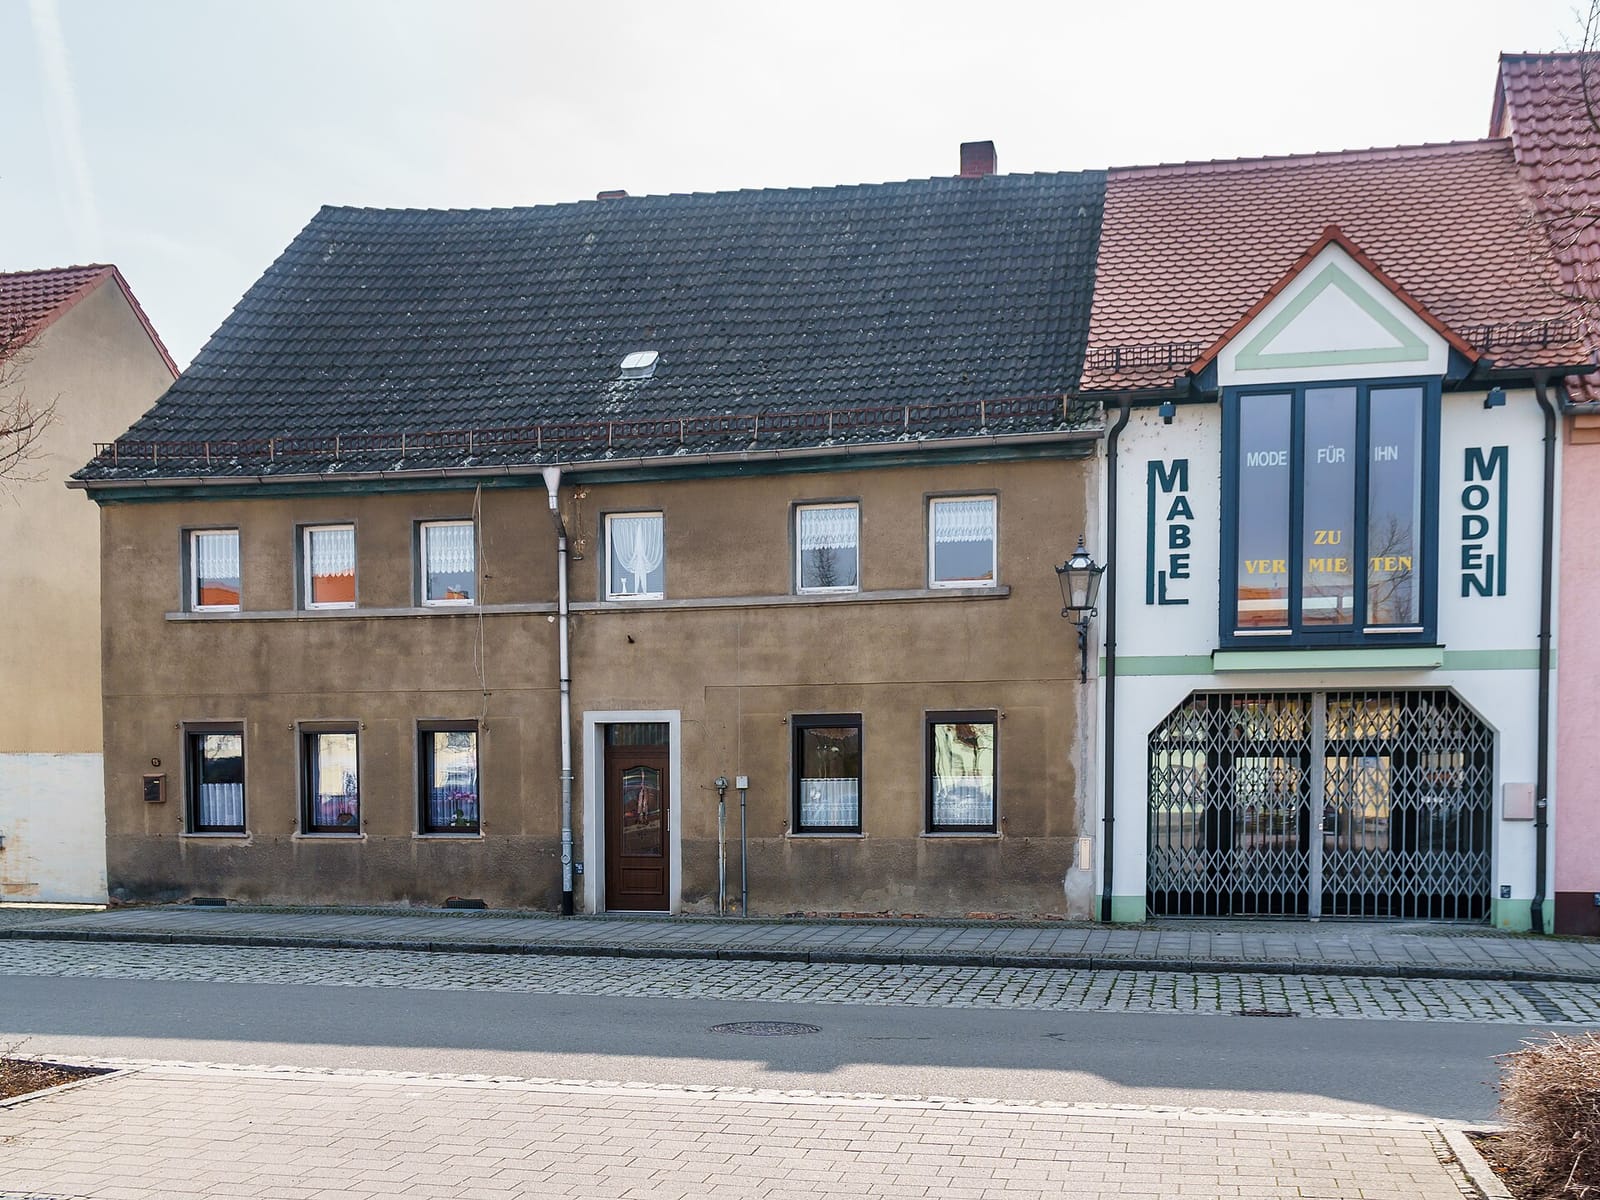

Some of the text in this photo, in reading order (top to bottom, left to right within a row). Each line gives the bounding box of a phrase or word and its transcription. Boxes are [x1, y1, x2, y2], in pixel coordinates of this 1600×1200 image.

[1247, 445, 1398, 467] MODE FÜR IHN
[1146, 459, 1194, 605] MABEL
[1461, 446, 1509, 597] MODEN
[1313, 529, 1342, 545] ZU
[1244, 556, 1412, 574] VER MIE TEN
